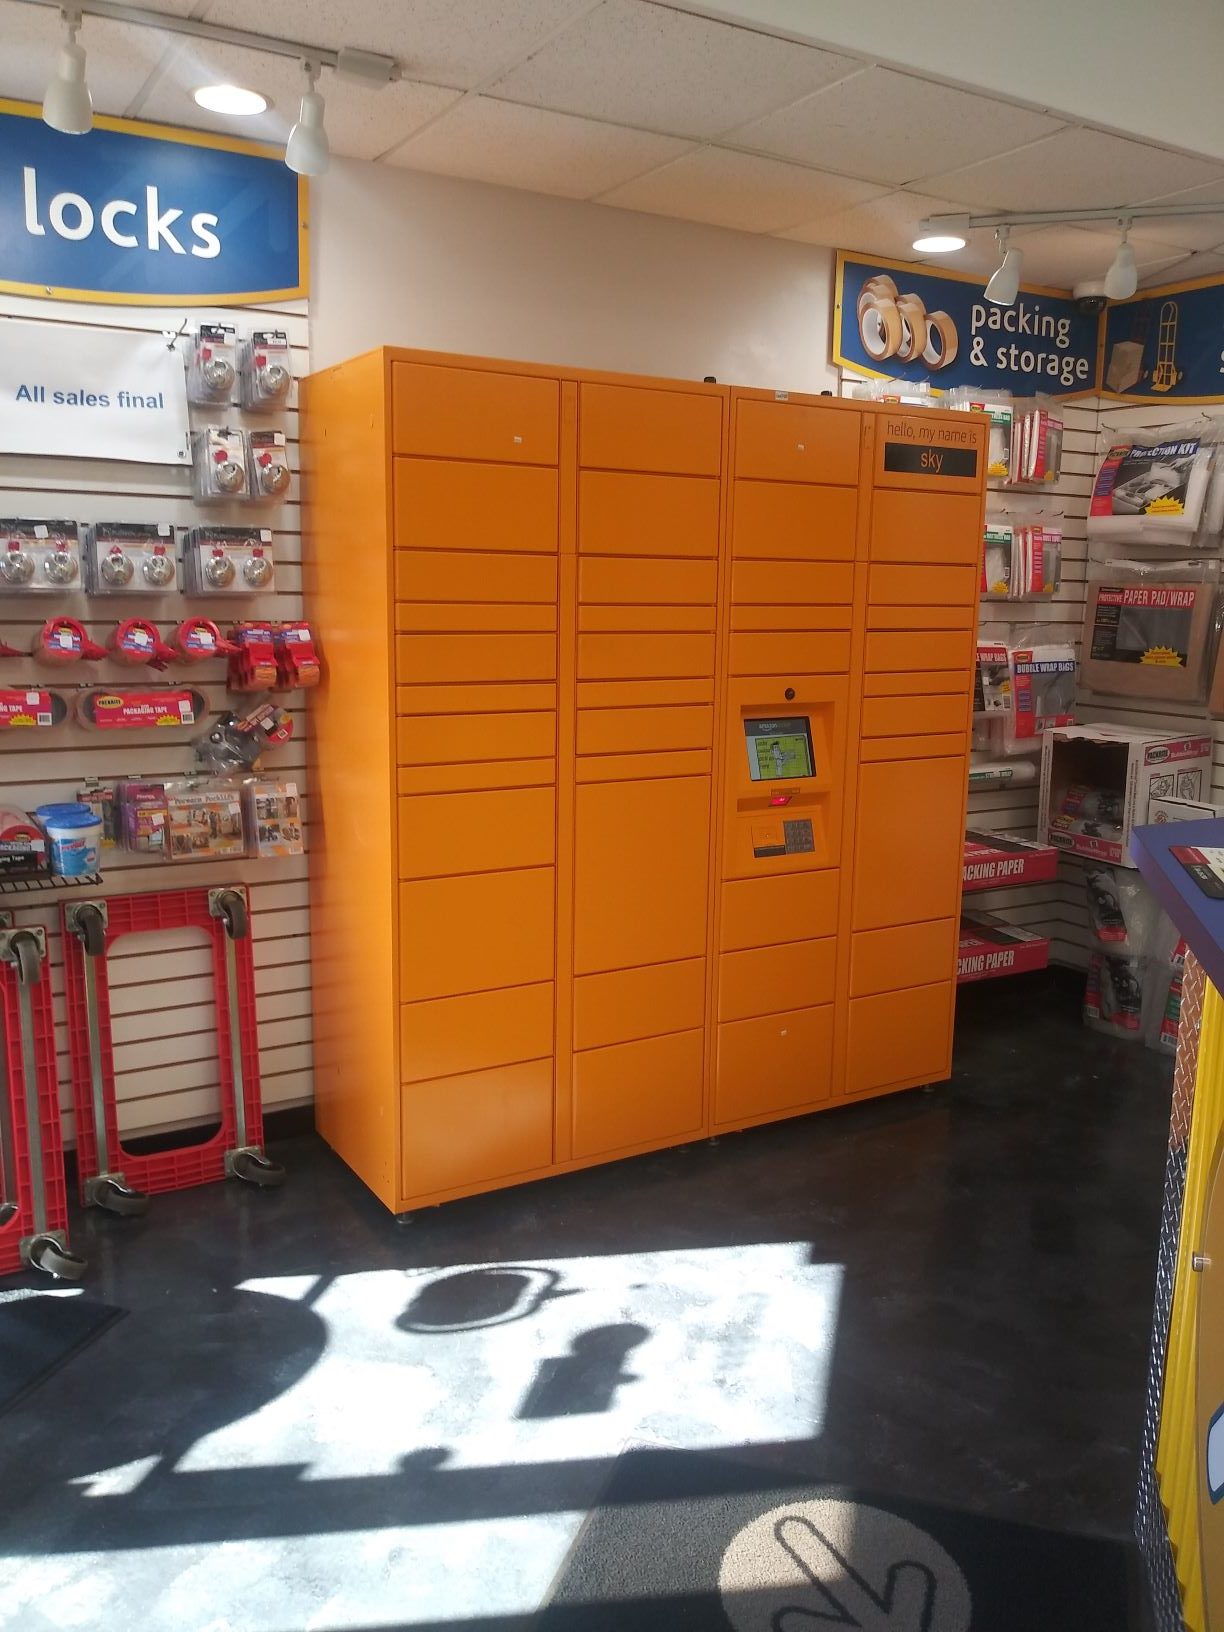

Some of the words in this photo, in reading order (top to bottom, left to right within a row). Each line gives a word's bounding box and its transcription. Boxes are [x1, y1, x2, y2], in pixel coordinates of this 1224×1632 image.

[24, 166, 222, 259] locks
[971, 303, 1070, 348] packing
[970, 336, 988, 367] &
[996, 343, 1088, 386] storage
[15, 384, 45, 403] All
[53, 389, 110, 408] sales
[118, 391, 164, 409] final
[887, 421, 915, 439] hello,
[919, 426, 936, 443] my
[939, 428, 966, 443] name
[970, 430, 977, 443] is
[920, 449, 944, 473] sky
[1129, 445, 1178, 458] PROECTION
[1178, 442, 1196, 455] KIT
[1124, 590, 1148, 605] PAPER
[1150, 591, 1195, 607] PAD/WRAP
[1040, 663, 1058, 673] WRAP
[9, 705, 22, 713] TAPE
[155, 706, 168, 714] TAPE
[962, 862, 996, 880] ACKING
[996, 858, 1025, 877] PAPER
[957, 957, 985, 976] CKING
[986, 950, 1015, 970] PAPER
